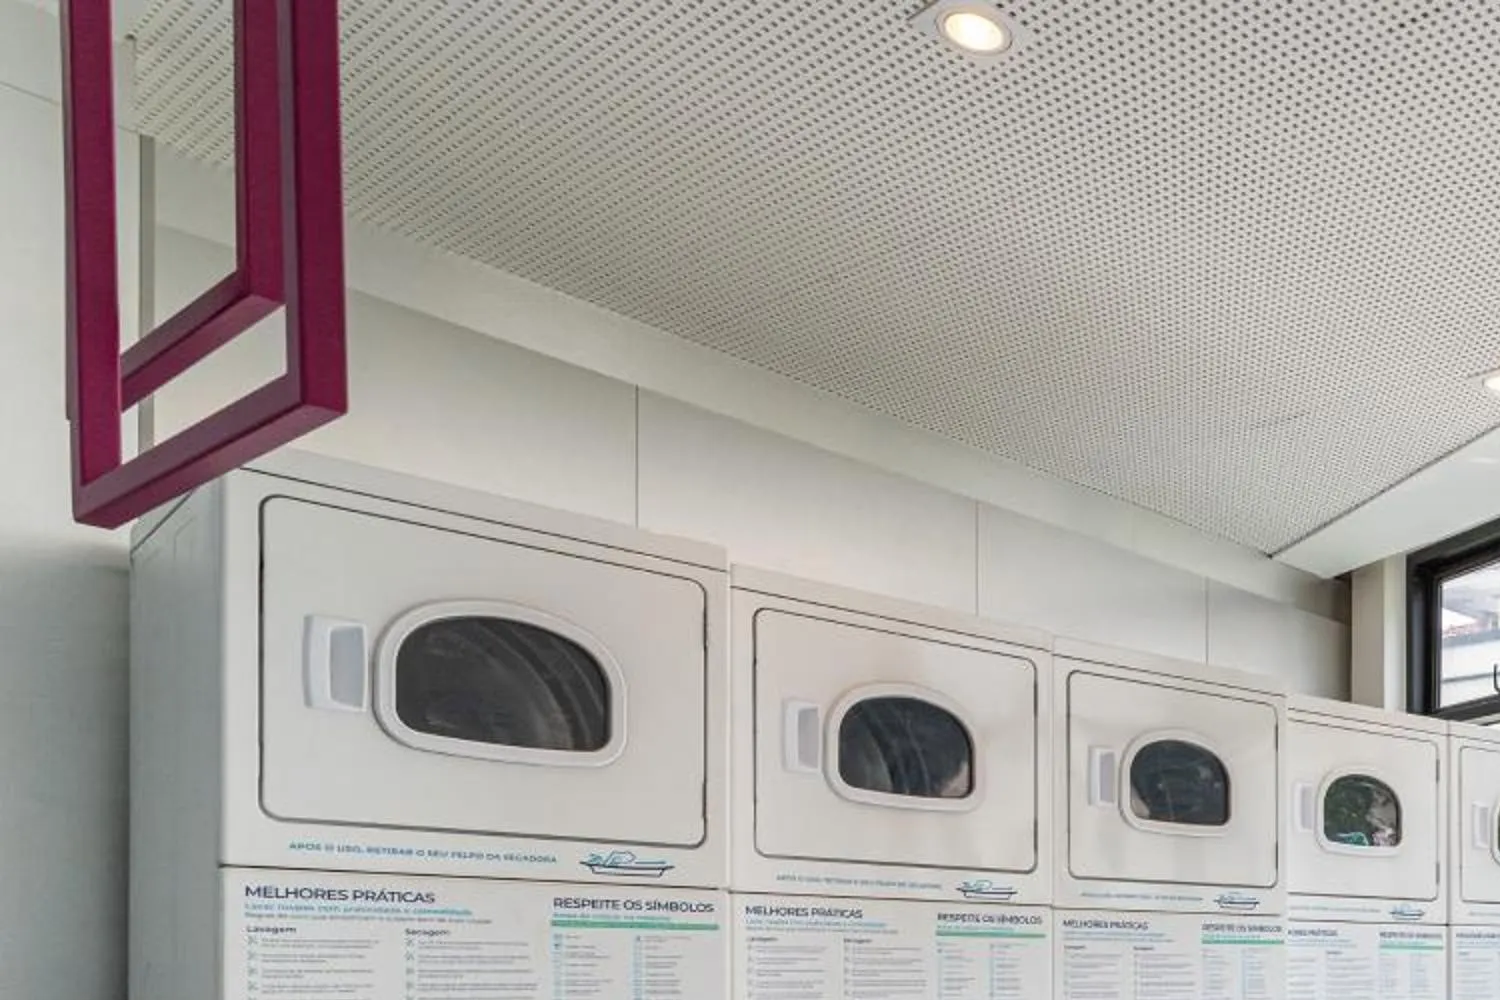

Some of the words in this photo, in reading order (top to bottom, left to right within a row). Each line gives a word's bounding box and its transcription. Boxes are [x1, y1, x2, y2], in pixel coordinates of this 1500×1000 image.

[245, 885, 349, 901] MELHORES
[353, 887, 435, 904] PRÁTICAS
[553, 897, 621, 910] RESPEITE
[623, 899, 643, 911] OS
[645, 899, 715, 913] SÍMBOLOS
[745, 905, 809, 918] MELHORES
